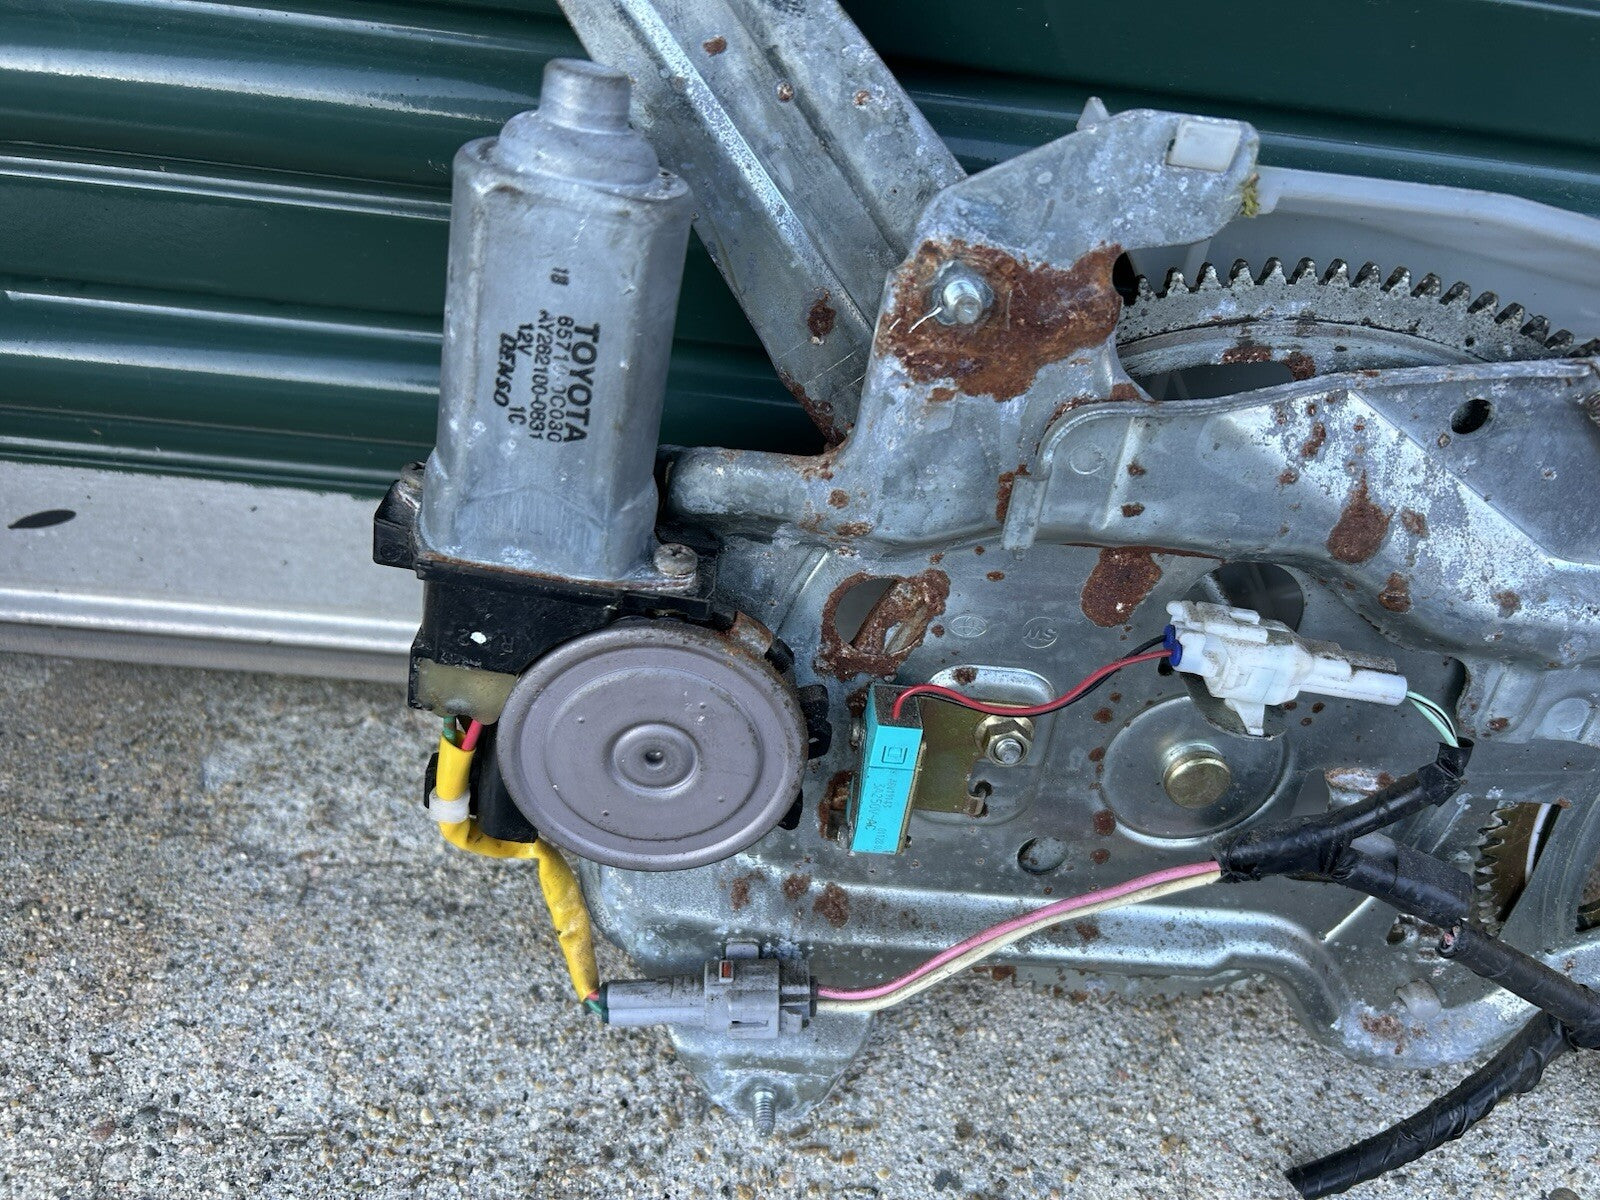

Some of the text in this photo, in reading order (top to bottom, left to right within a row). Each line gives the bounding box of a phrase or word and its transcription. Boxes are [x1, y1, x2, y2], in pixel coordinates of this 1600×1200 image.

[493, 332, 518, 408] DENSO
[507, 322, 534, 426] 12V 1C
[563, 322, 600, 443] TOYOTA
